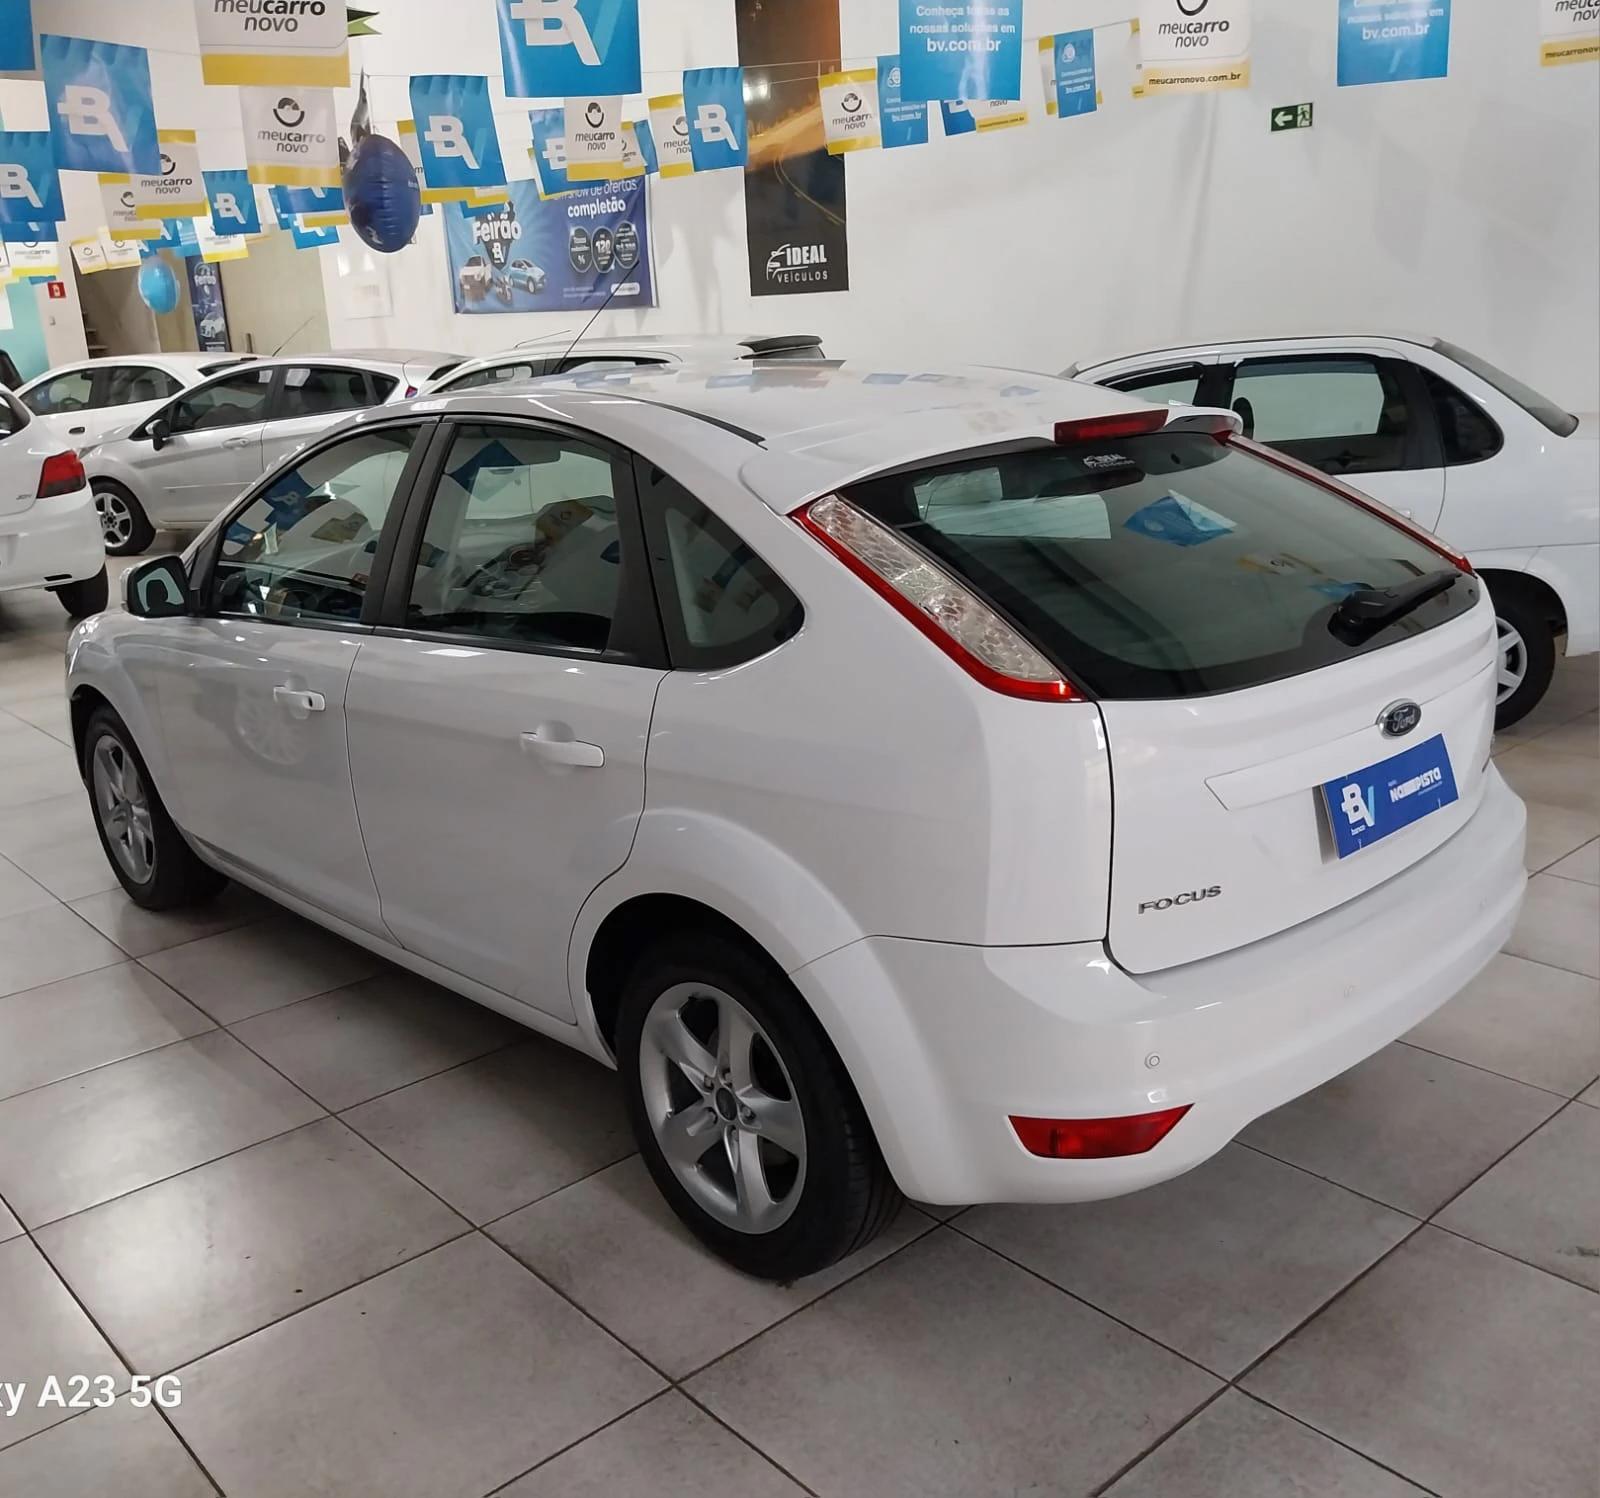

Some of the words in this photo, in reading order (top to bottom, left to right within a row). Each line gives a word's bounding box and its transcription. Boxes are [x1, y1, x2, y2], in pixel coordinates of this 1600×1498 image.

[213, 0, 326, 16] meucarro
[915, 6, 964, 18] Conheça
[244, 16, 299, 33] novo
[909, 24, 949, 34] nossas
[1000, 25, 1016, 34] em
[1158, 20, 1230, 35] meucarro
[1362, 23, 1431, 41] bv.com.br
[926, 38, 1002, 53] bv.com.br
[1175, 35, 1210, 48] novo
[1148, 72, 1242, 86] meucarronovo.com.br
[844, 120, 867, 131] novo
[257, 130, 327, 145] meucarro
[575, 131, 616, 143] meucarro
[276, 142, 310, 154] novo
[587, 141, 607, 152] novo
[140, 177, 193, 188] meucarro
[155, 186, 181, 195] novo
[567, 196, 627, 219] completão
[786, 244, 828, 267] IDEAL
[776, 270, 829, 284] VEÍCULOS
[1391, 706, 1417, 733] Ford
[1137, 885, 1222, 915] FOCUS
